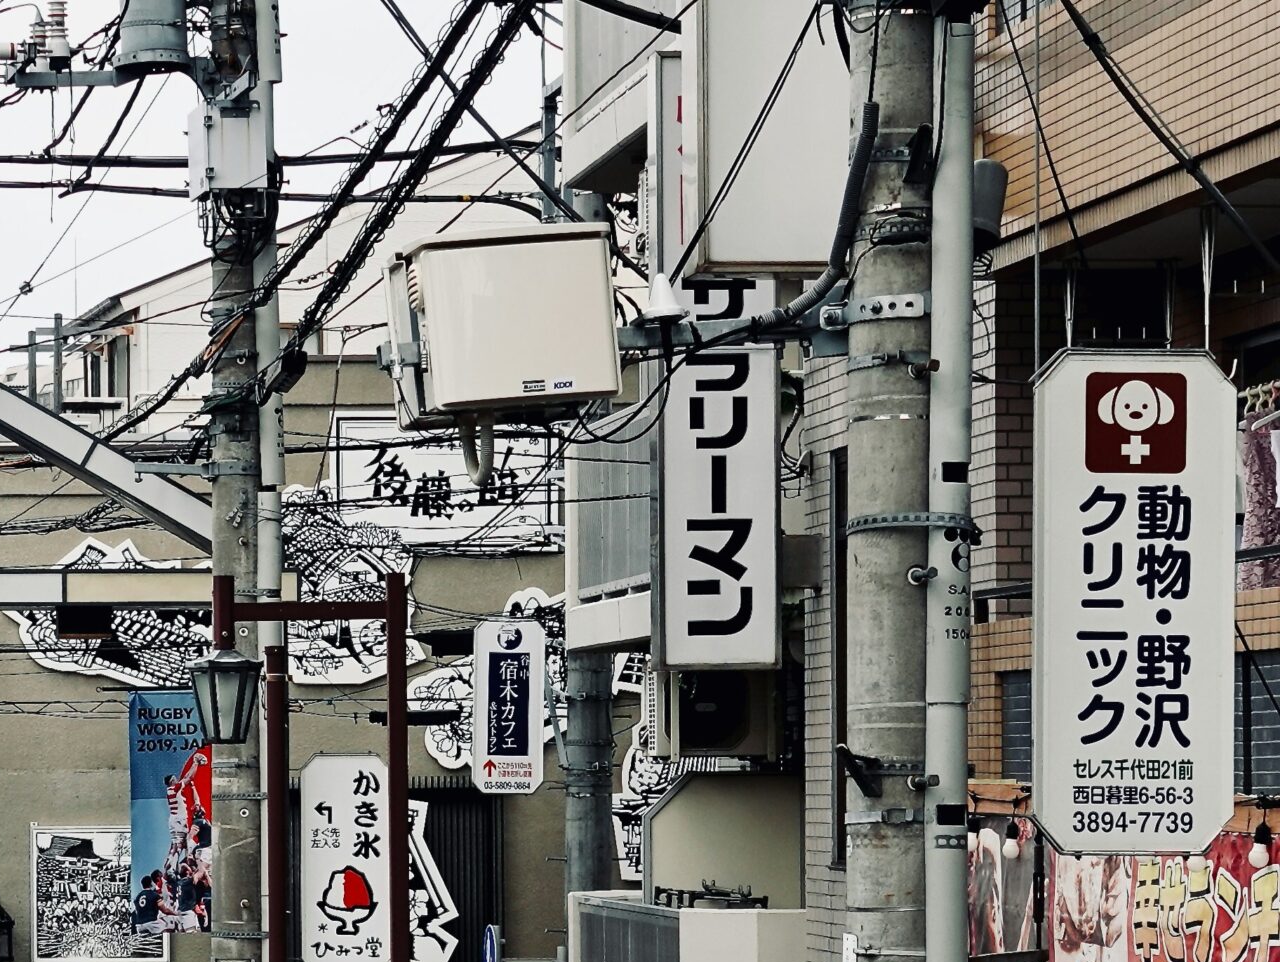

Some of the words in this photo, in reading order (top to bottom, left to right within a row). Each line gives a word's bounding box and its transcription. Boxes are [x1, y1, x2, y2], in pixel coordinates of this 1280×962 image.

[554, 381, 573, 390] KDDI
[1076, 485, 1128, 745] クリニック
[1135, 484, 1191, 748] 動物・野沢
[138, 708, 193, 720] RUGBY
[499, 659, 519, 749] 宿木カフェ
[138, 724, 198, 735] WORLD
[489, 701, 498, 753] &レストラン
[138, 740, 176, 753] 2019,
[1073, 759, 1193, 781] セレス千代田21前
[1073, 786, 1193, 805] 西日暮里6-56-3
[352, 770, 381, 859] かき氷
[1073, 811, 1193, 833] 3894-7739
[311, 828, 340, 838] すぐ先
[311, 838, 341, 849] 左入る
[311, 937, 383, 957] ひみつ堂
